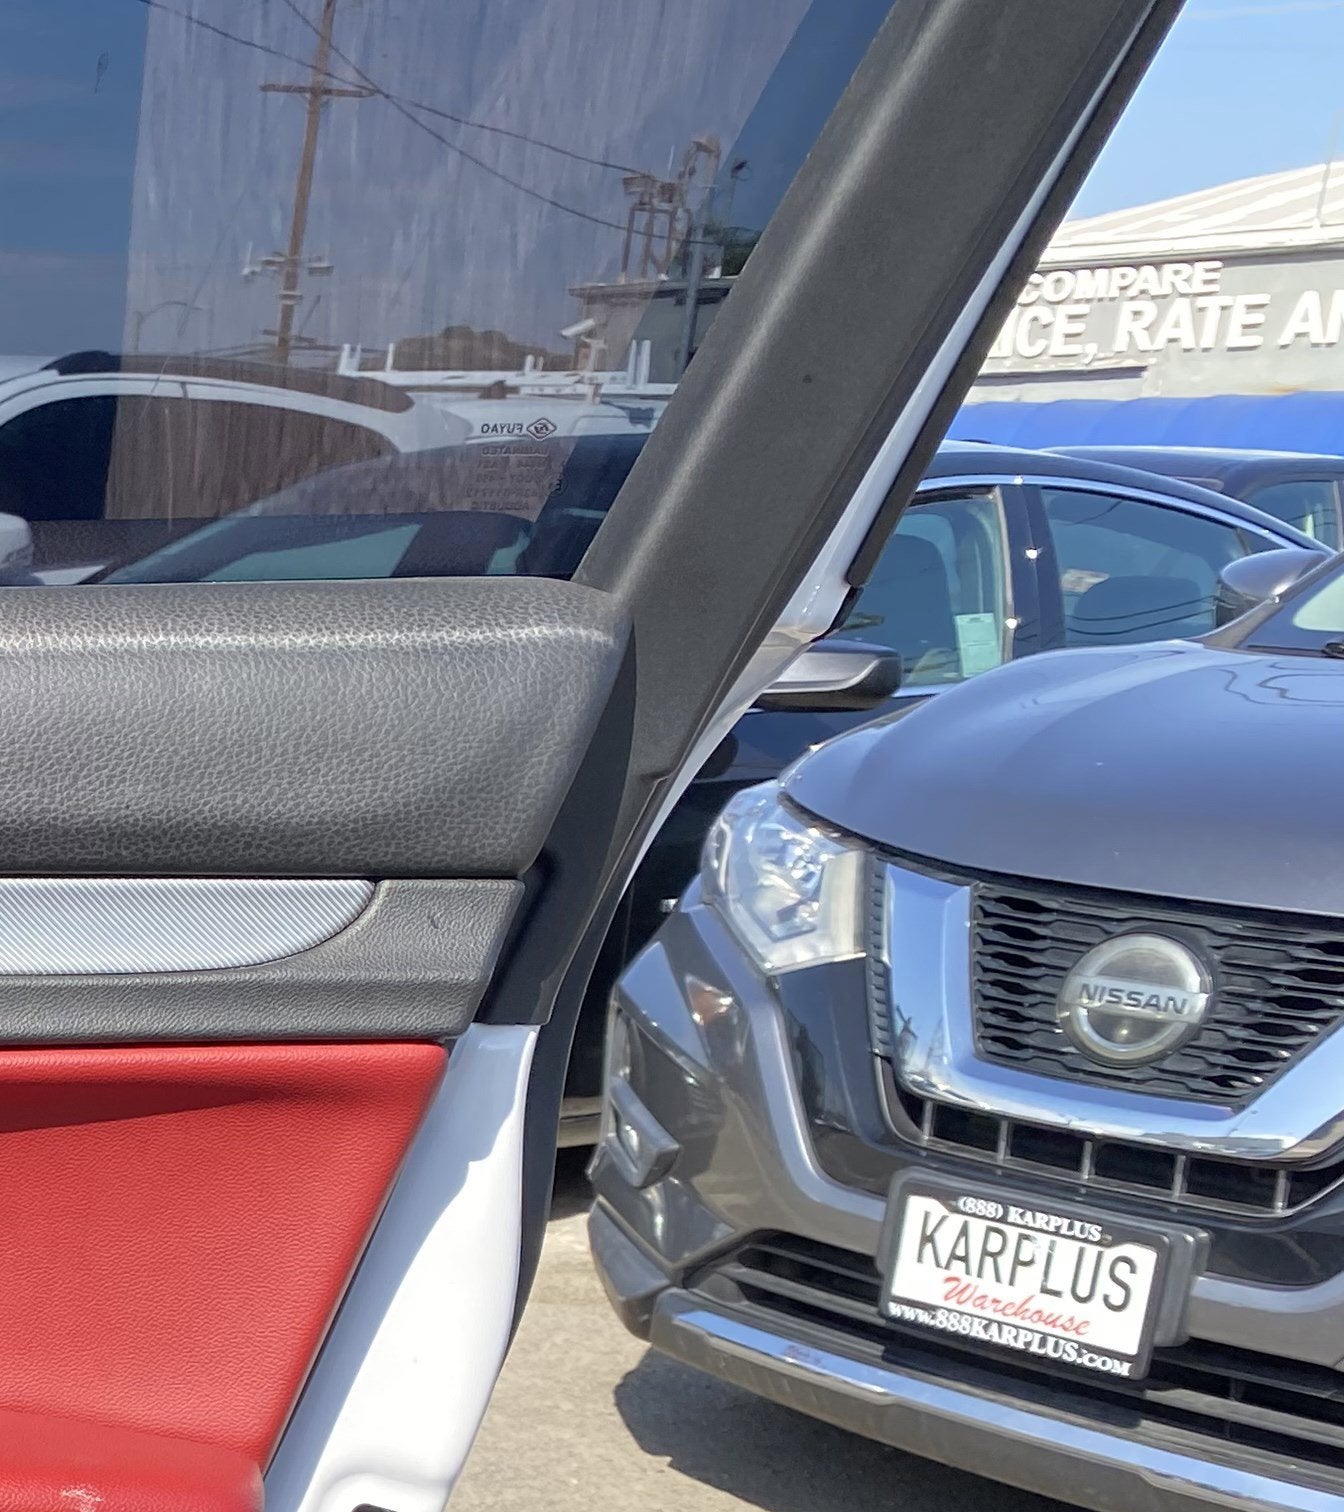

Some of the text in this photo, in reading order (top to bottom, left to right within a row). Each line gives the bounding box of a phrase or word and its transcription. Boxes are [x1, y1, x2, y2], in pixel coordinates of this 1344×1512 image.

[1017, 261, 1223, 306] COMPARE
[1112, 293, 1272, 353] RATE
[1079, 983, 1188, 1015] NISSAN
[956, 1196, 1103, 1243] (888) KARPLUS
[916, 1210, 1139, 1313] KARPLUS
[943, 1275, 1091, 1337] Warehouse
